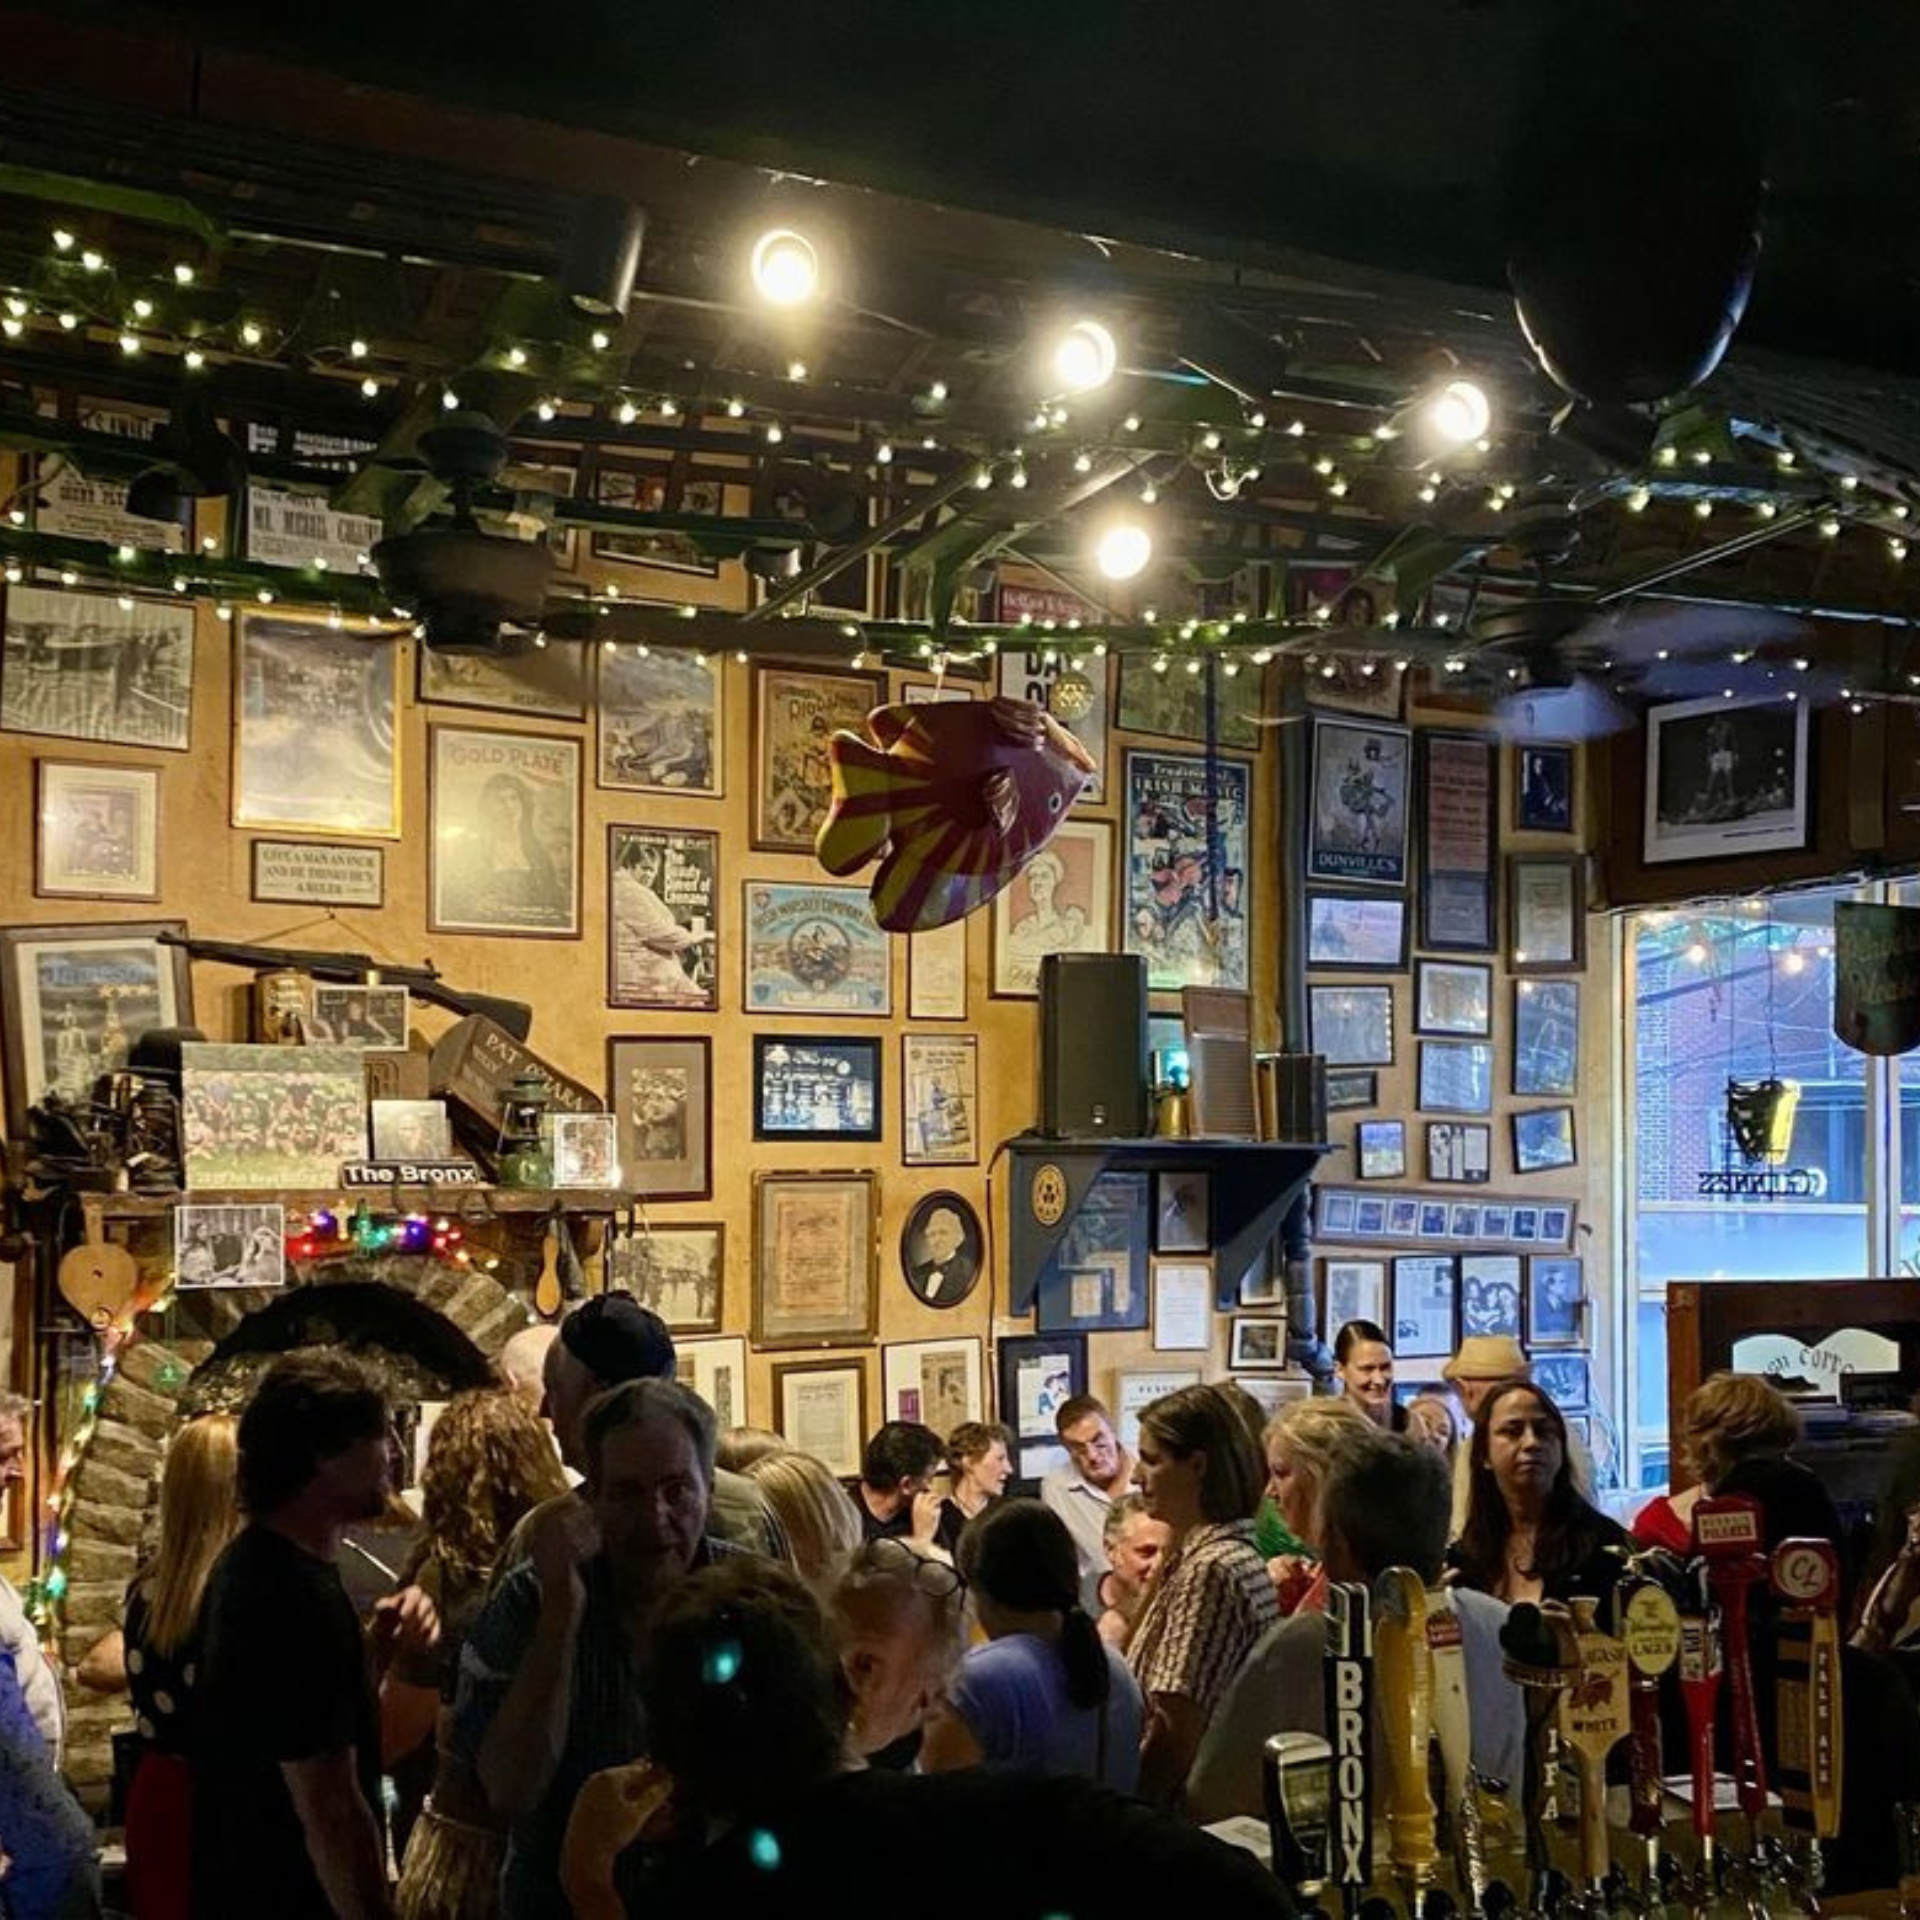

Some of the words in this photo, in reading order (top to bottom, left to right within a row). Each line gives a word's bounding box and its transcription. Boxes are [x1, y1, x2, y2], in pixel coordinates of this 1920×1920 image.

[453, 748, 504, 765] GOLD
[509, 748, 563, 774] PLATE
[1135, 777, 1183, 793] IRISH
[303, 852, 328, 864] MAN
[331, 854, 345, 865] AN
[267, 866, 289, 877] AND
[290, 866, 305, 878] HE
[486, 1033, 521, 1064] PAT
[344, 1165, 395, 1182] The
[400, 1165, 476, 1183] Bronx
[1818, 1652, 1828, 1719] PALE
[1572, 1717, 1619, 1732] WHITE
[1818, 1734, 1828, 1783] ALE
[1336, 1660, 1365, 1884] BRONX
